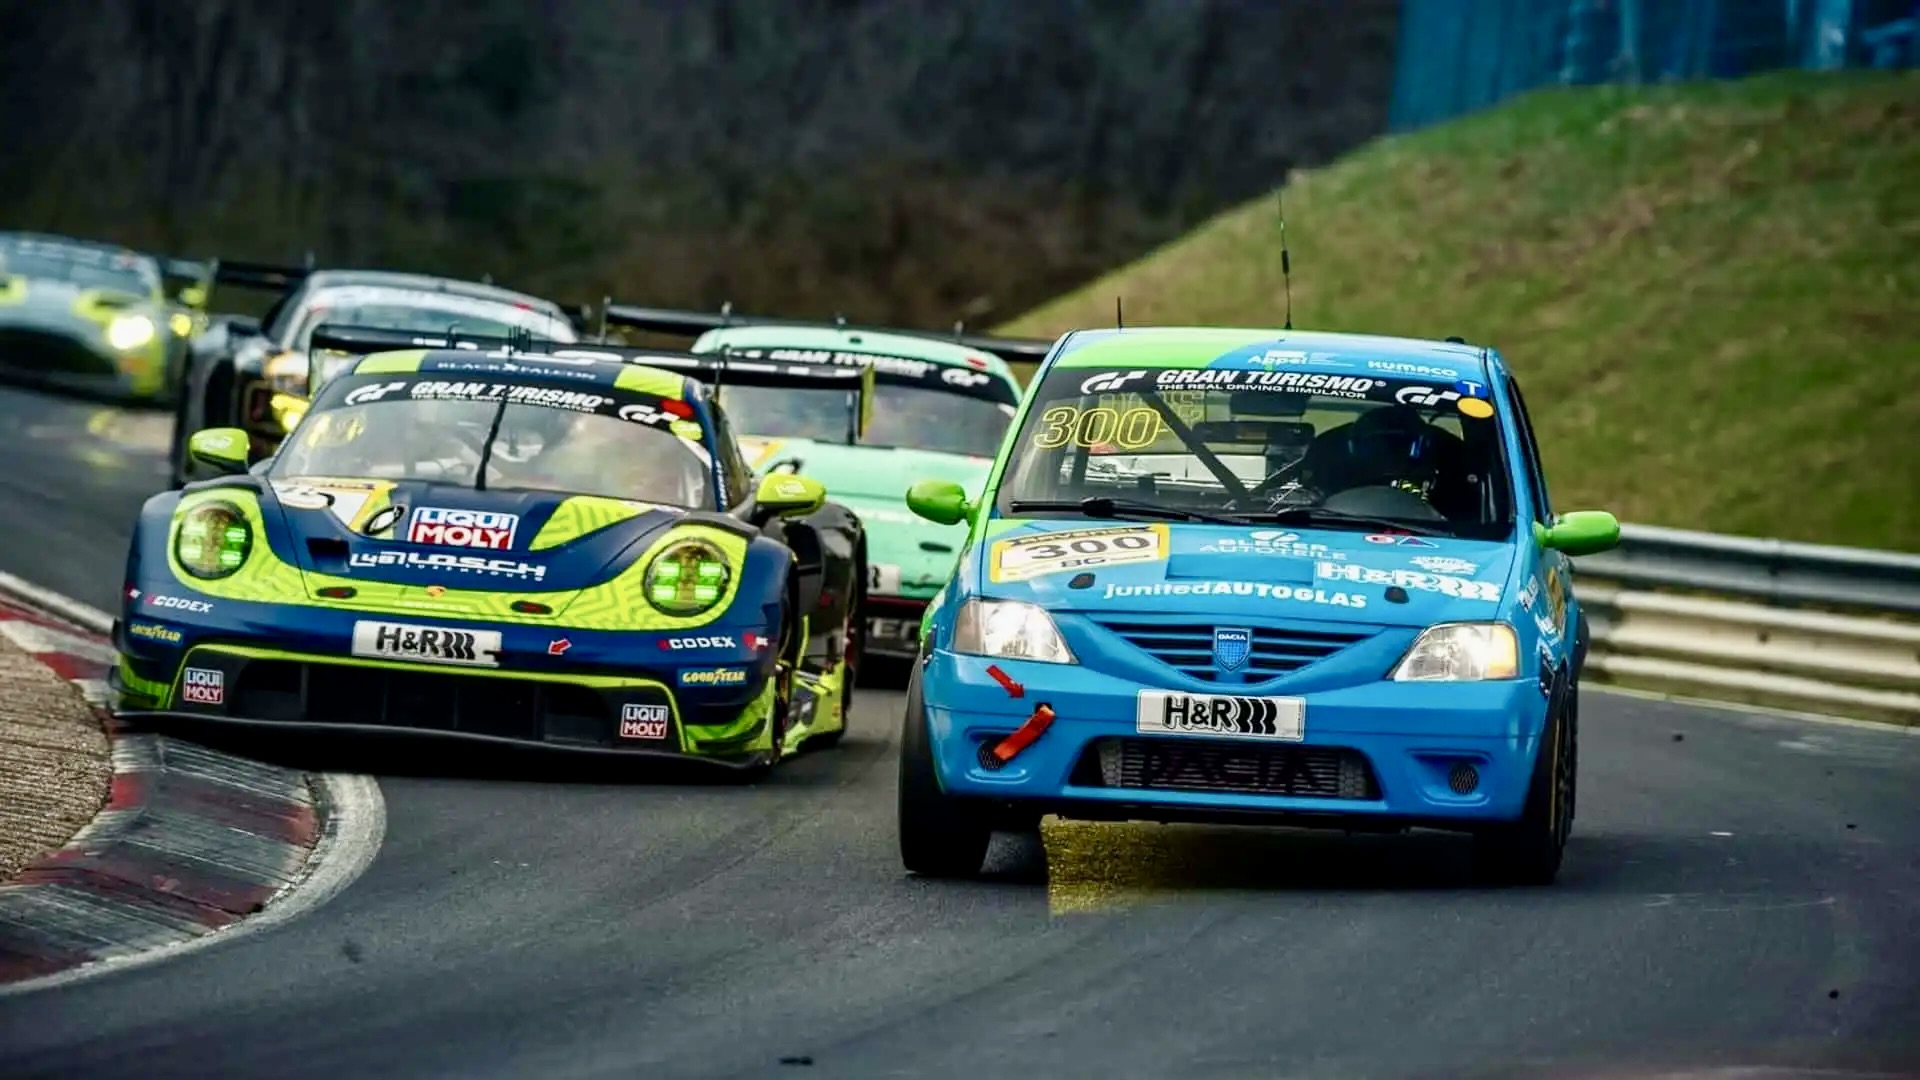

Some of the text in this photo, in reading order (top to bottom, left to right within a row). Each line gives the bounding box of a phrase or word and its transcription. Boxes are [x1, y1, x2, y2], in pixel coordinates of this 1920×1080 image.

[1156, 370, 1236, 385] GRAN
[411, 381, 486, 396] GRAN
[1226, 384, 1282, 393] DRIVING
[1286, 386, 1367, 400] SIMULATOR
[1464, 381, 1483, 396] T
[1034, 407, 1161, 449] 300
[419, 510, 511, 529] LIQUI
[415, 523, 511, 549] MOLY
[1025, 535, 1151, 559] 300
[152, 595, 213, 613] CODEX
[376, 625, 440, 656] H&R
[669, 636, 736, 649] CODEX
[1217, 633, 1247, 642] DACIA
[187, 671, 221, 687] LIQUI
[682, 667, 746, 685] GOODYEAR
[185, 685, 221, 701] MOLY
[625, 706, 667, 722] LIQUI
[1162, 695, 1237, 731] H&R
[623, 722, 665, 738] MOLY
